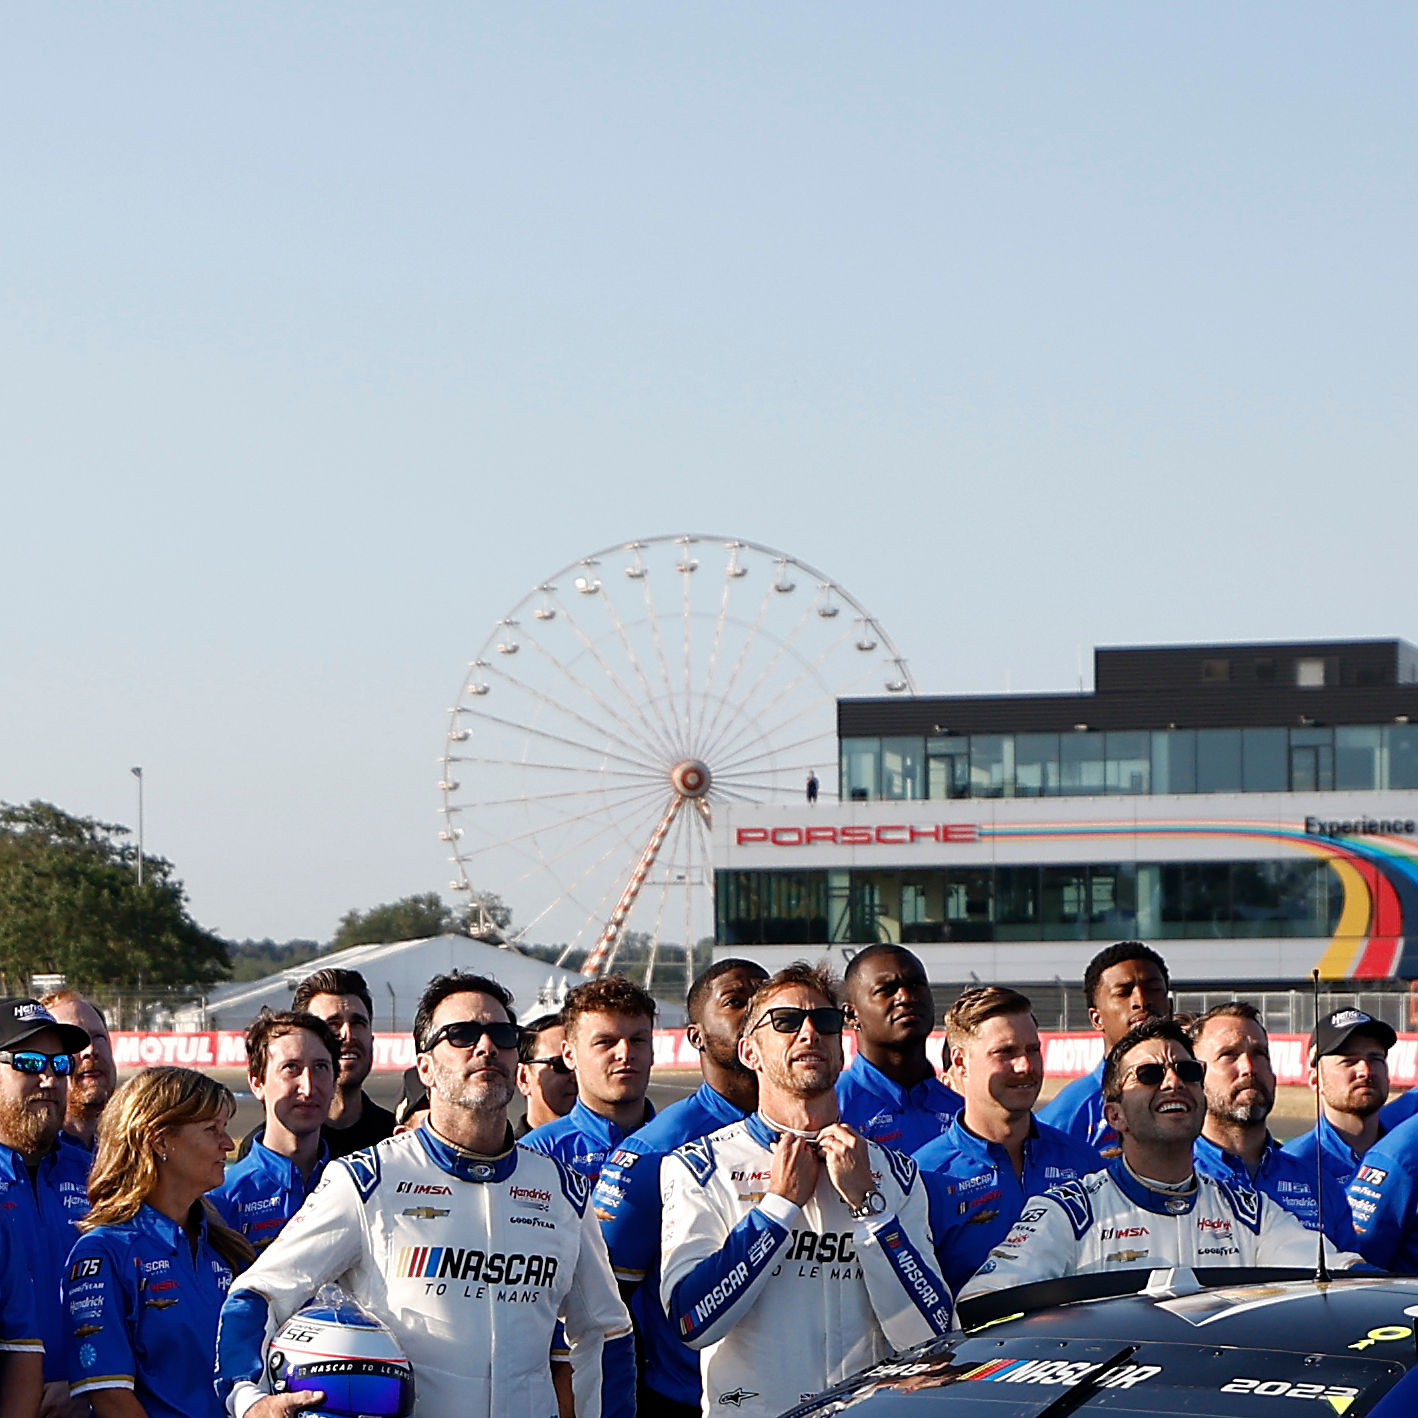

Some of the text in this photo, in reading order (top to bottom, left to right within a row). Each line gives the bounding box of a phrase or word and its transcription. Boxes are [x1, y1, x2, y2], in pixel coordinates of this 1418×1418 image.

[737, 822, 978, 845] PORSCHE
[1304, 816, 1415, 837] Experience
[115, 1036, 214, 1062] MOTUL
[1045, 1039, 1106, 1071] MOTU
[619, 1153, 639, 1168] 75
[745, 1171, 771, 1181] IMS
[958, 1174, 992, 1191] NASCAR
[1365, 1169, 1386, 1185] 75
[413, 1184, 453, 1196] IMSA
[509, 1185, 552, 1202] Hendrick
[245, 1197, 281, 1213] NASCAR
[509, 1217, 556, 1230] GOODYEAR
[1022, 1210, 1045, 1222] 75
[1115, 1227, 1150, 1239] IMSA
[751, 1232, 776, 1267] 56
[83, 1259, 101, 1276] 75
[439, 1247, 558, 1289] NASCAR
[799, 1266, 818, 1278] LE
[831, 1268, 864, 1280] MAN
[896, 1249, 940, 1309] NASCAR
[425, 1283, 540, 1304] TO LE MANS
[694, 1261, 750, 1323] NASCAR
[283, 1328, 320, 1343] 56
[310, 1363, 354, 1374] NASCAR
[362, 1364, 374, 1372] TO
[381, 1366, 390, 1374] LE
[863, 1363, 931, 1377] 1948
[1220, 1377, 1360, 1400] 2023
